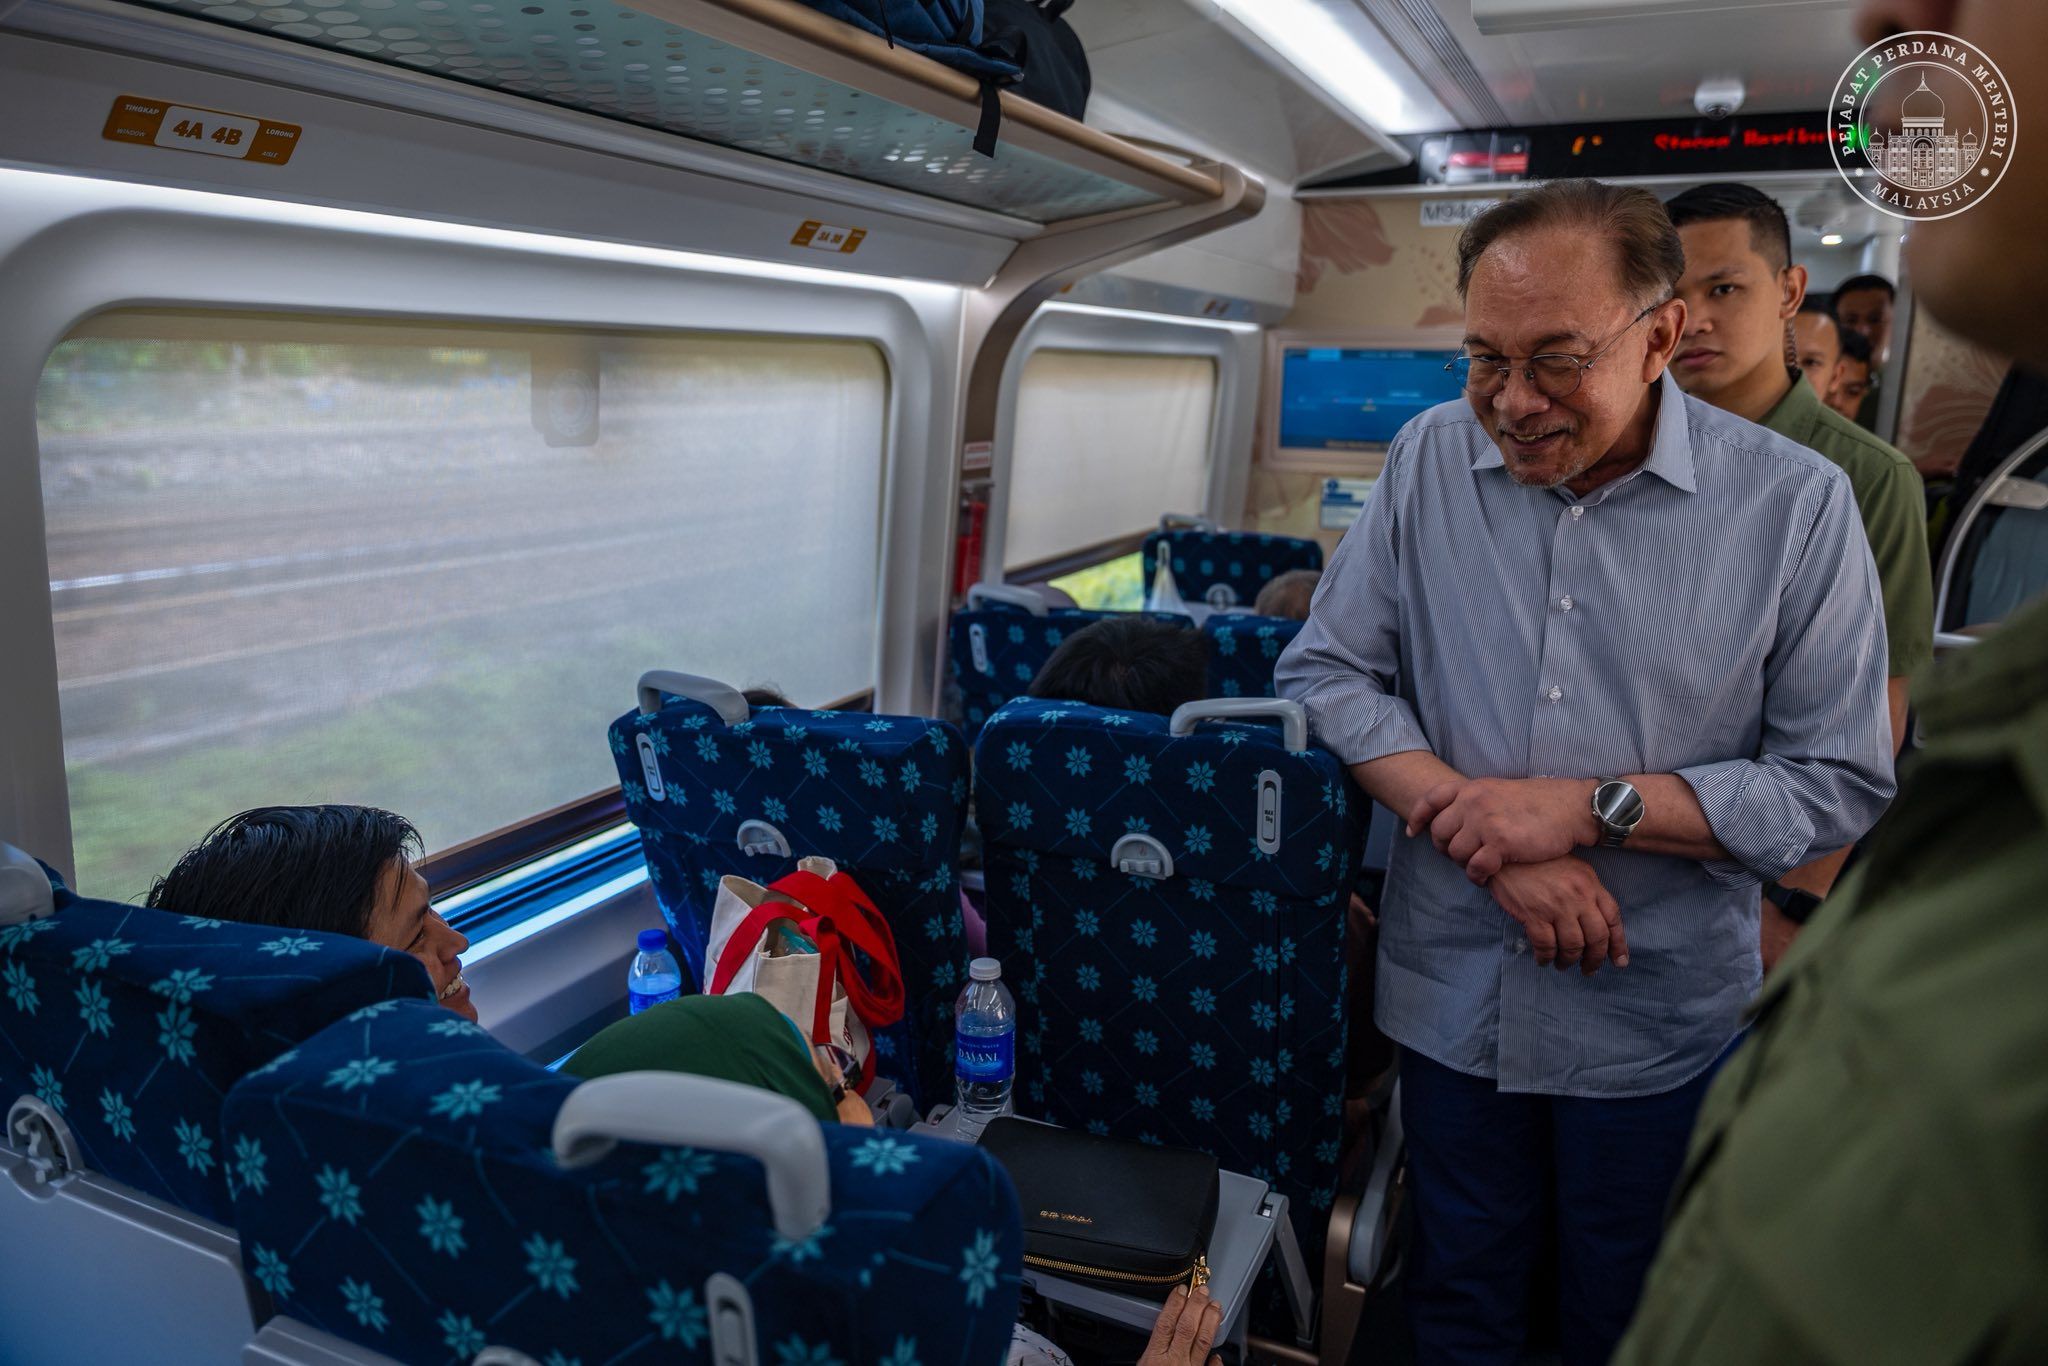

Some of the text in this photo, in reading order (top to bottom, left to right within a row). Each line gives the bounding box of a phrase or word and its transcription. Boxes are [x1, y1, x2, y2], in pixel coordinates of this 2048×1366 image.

[124, 103, 160, 115] TINGKAP
[172, 119, 243, 146] 4A 4B
[265, 128, 295, 139] LORONG
